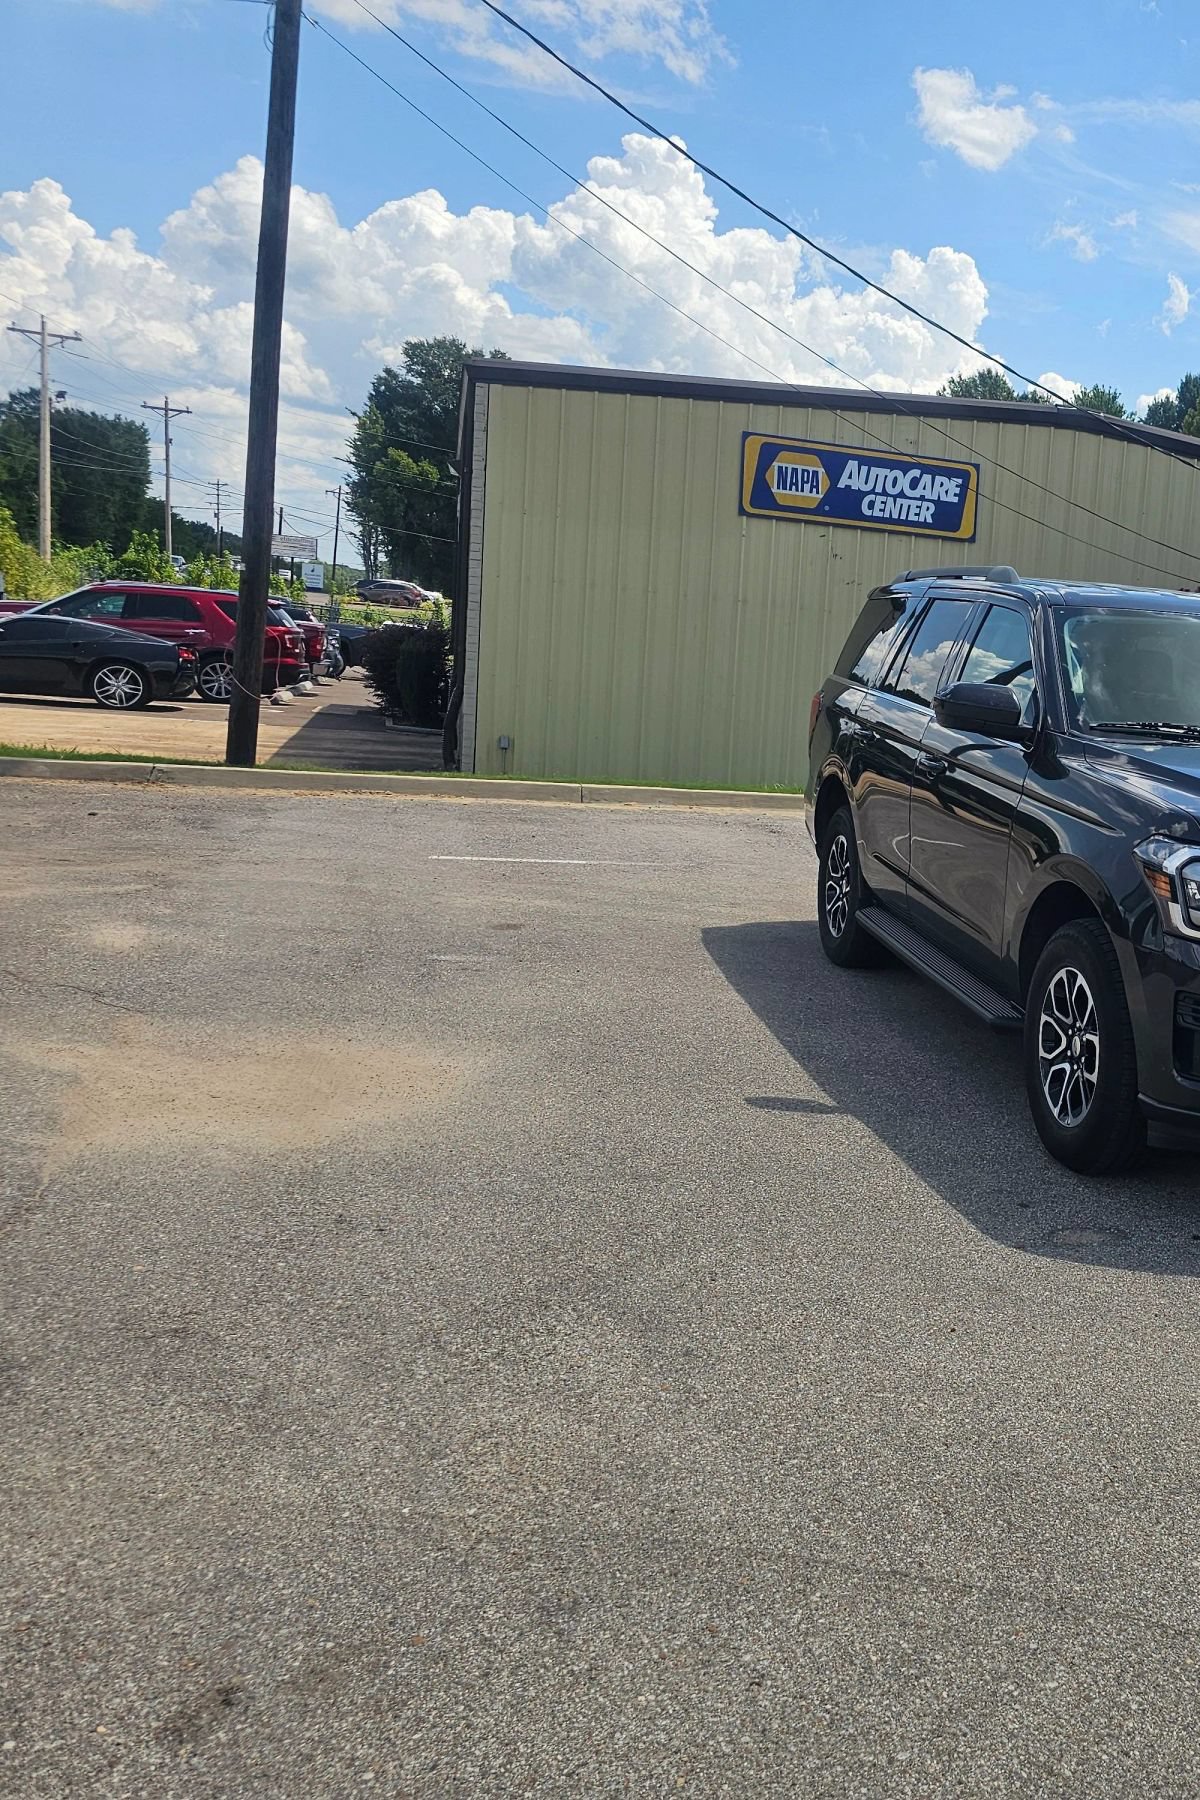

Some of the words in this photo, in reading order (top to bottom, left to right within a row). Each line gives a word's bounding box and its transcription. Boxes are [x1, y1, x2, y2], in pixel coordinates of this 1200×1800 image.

[776, 465, 821, 495] NAPA
[837, 460, 962, 503] AUTOCARE
[861, 495, 935, 523] CENTER
